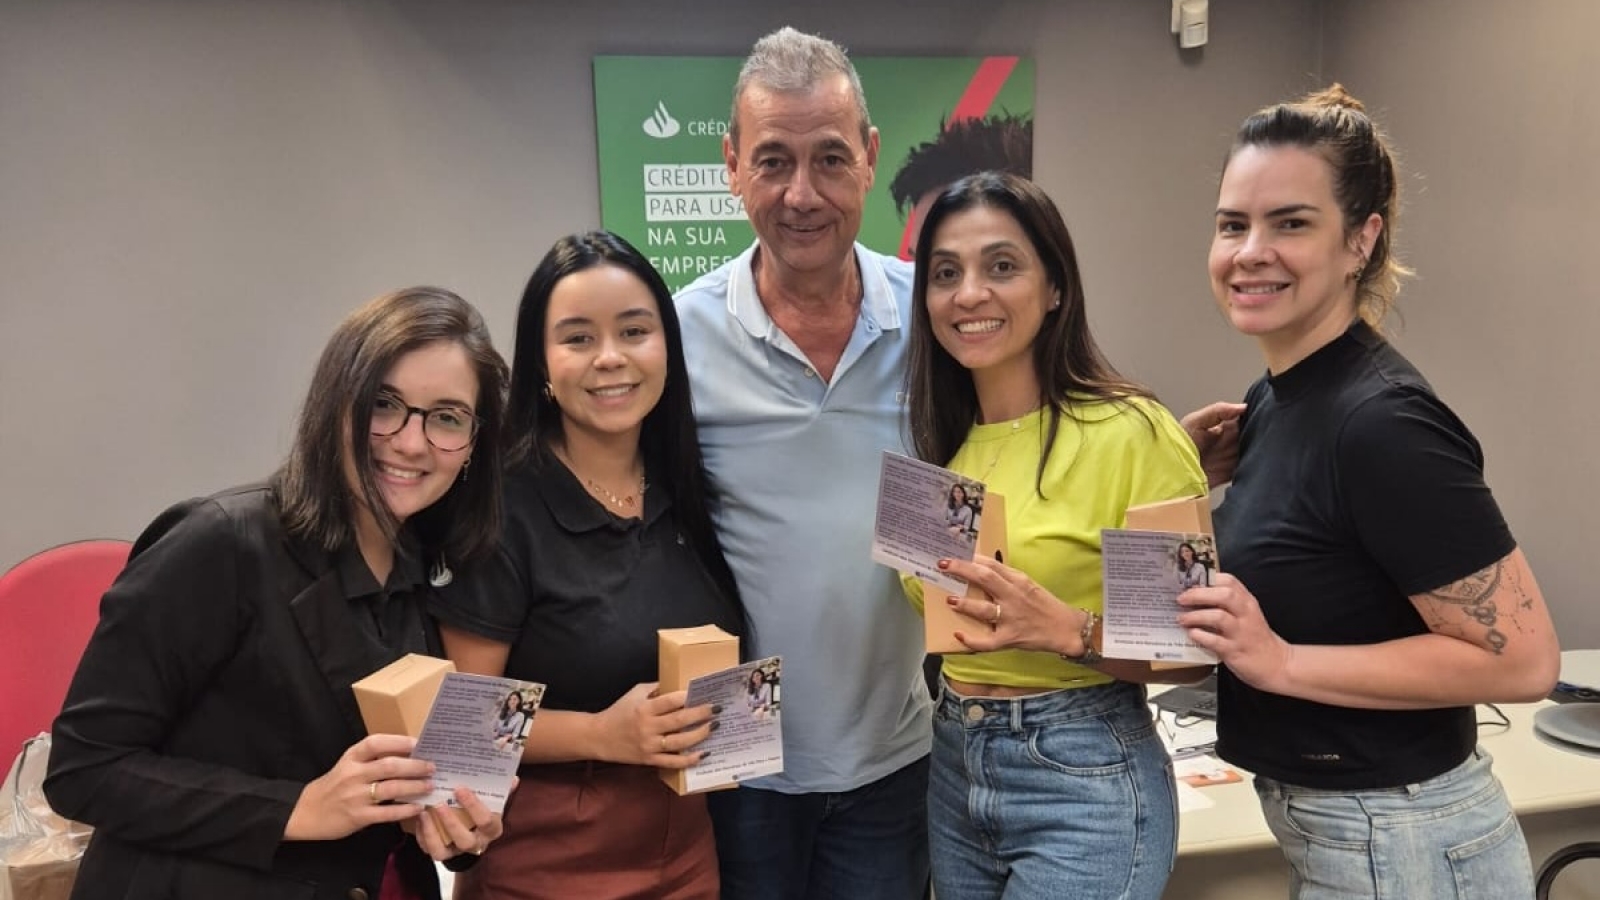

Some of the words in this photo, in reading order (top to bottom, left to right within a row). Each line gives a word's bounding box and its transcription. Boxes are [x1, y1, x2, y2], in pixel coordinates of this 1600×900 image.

[649, 197, 702, 216] PARA
[647, 227, 677, 246] NA
[685, 227, 727, 246] SUA
